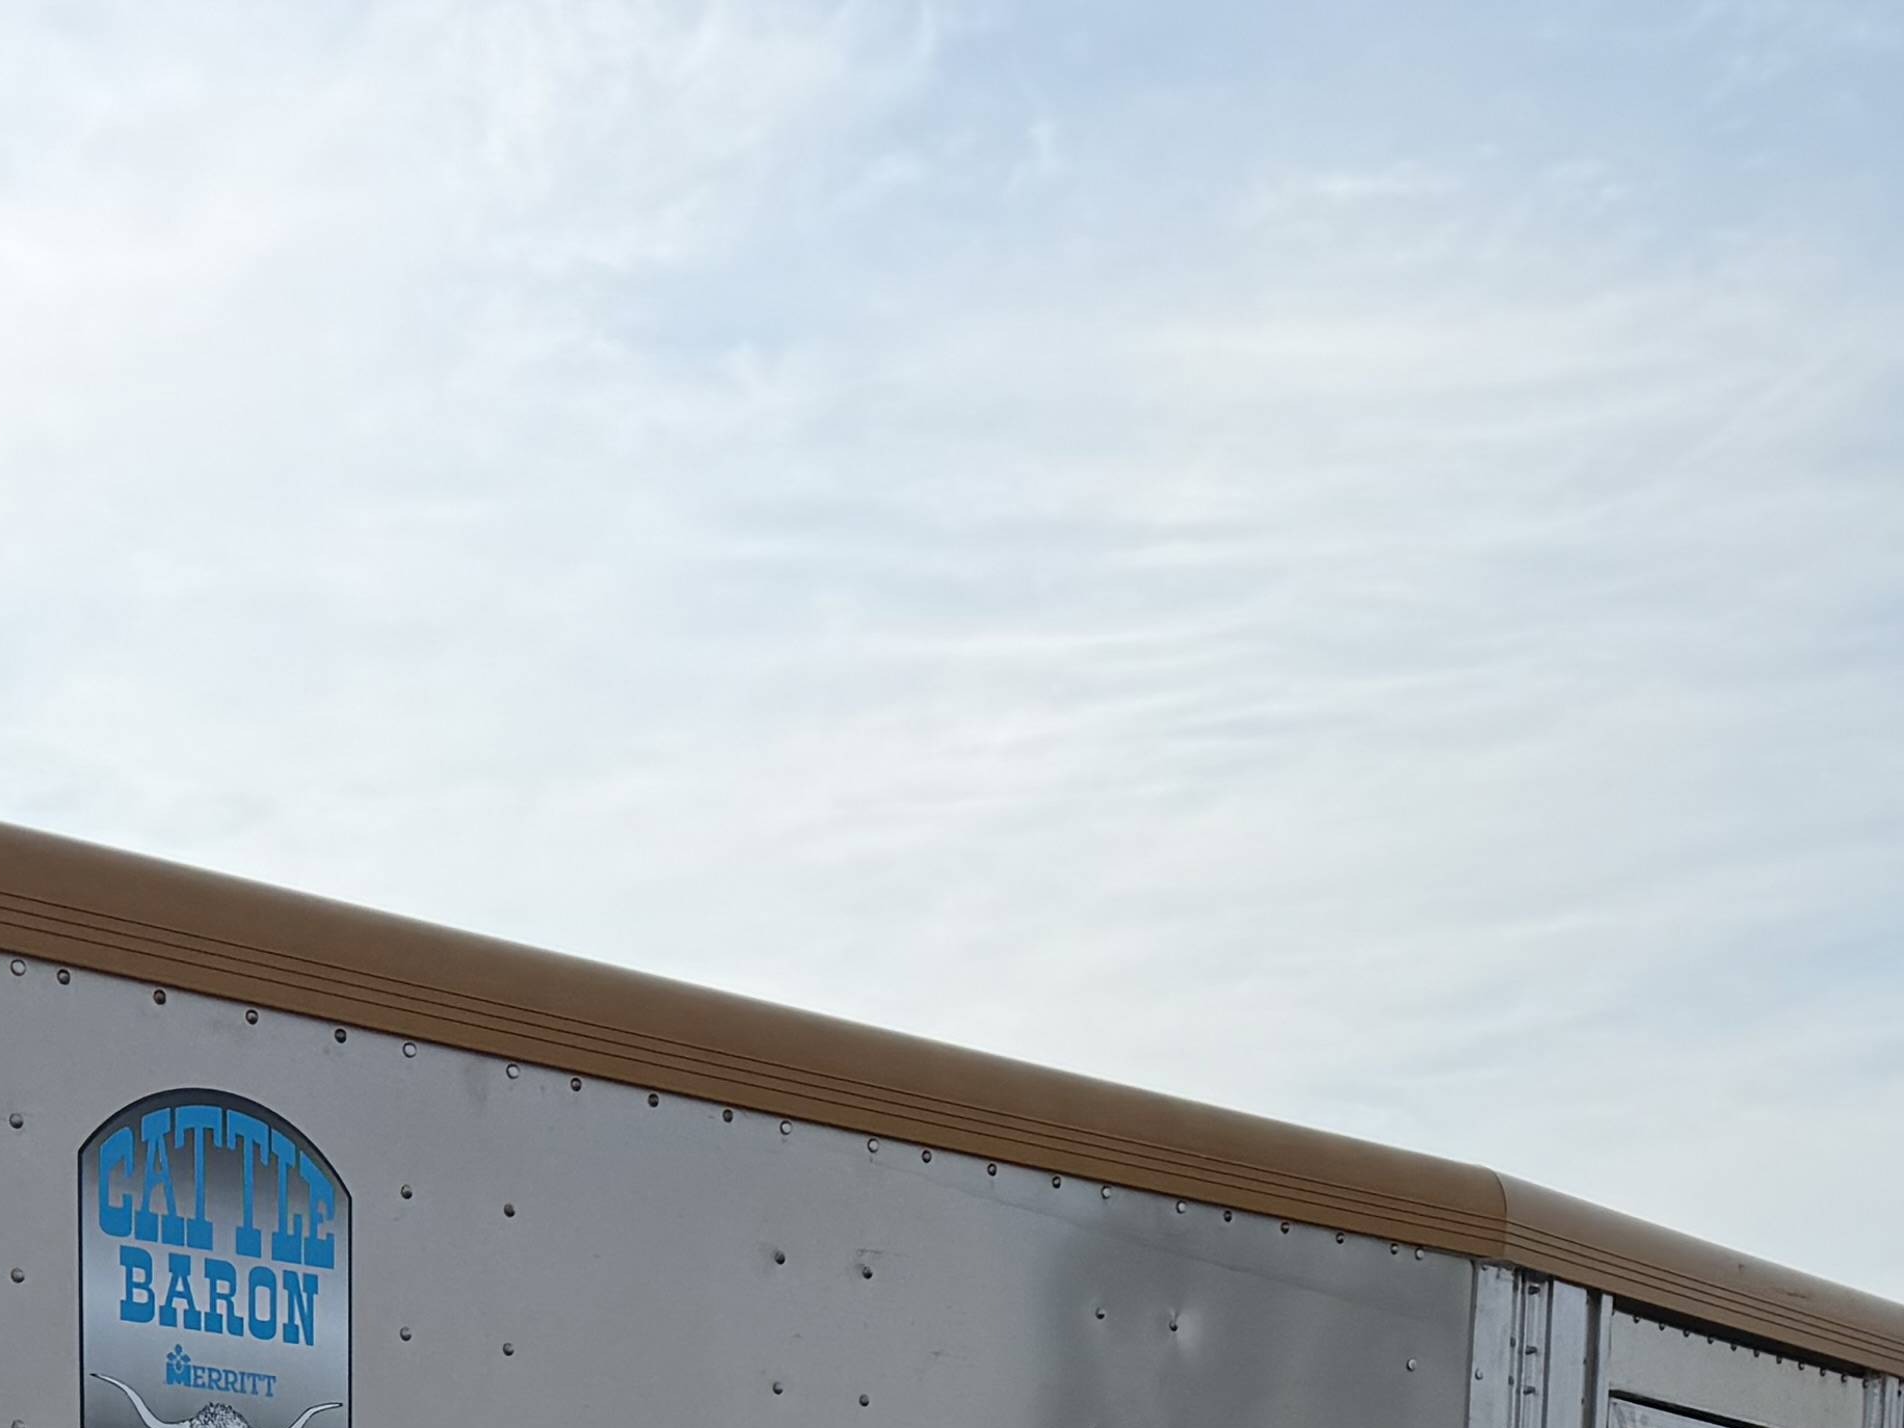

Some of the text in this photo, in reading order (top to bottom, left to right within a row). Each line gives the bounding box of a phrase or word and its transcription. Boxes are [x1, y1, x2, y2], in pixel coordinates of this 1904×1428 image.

[98, 1105, 335, 1269] CATTLE
[119, 1246, 319, 1347] BARON
[165, 1357, 277, 1398] MERRITT
